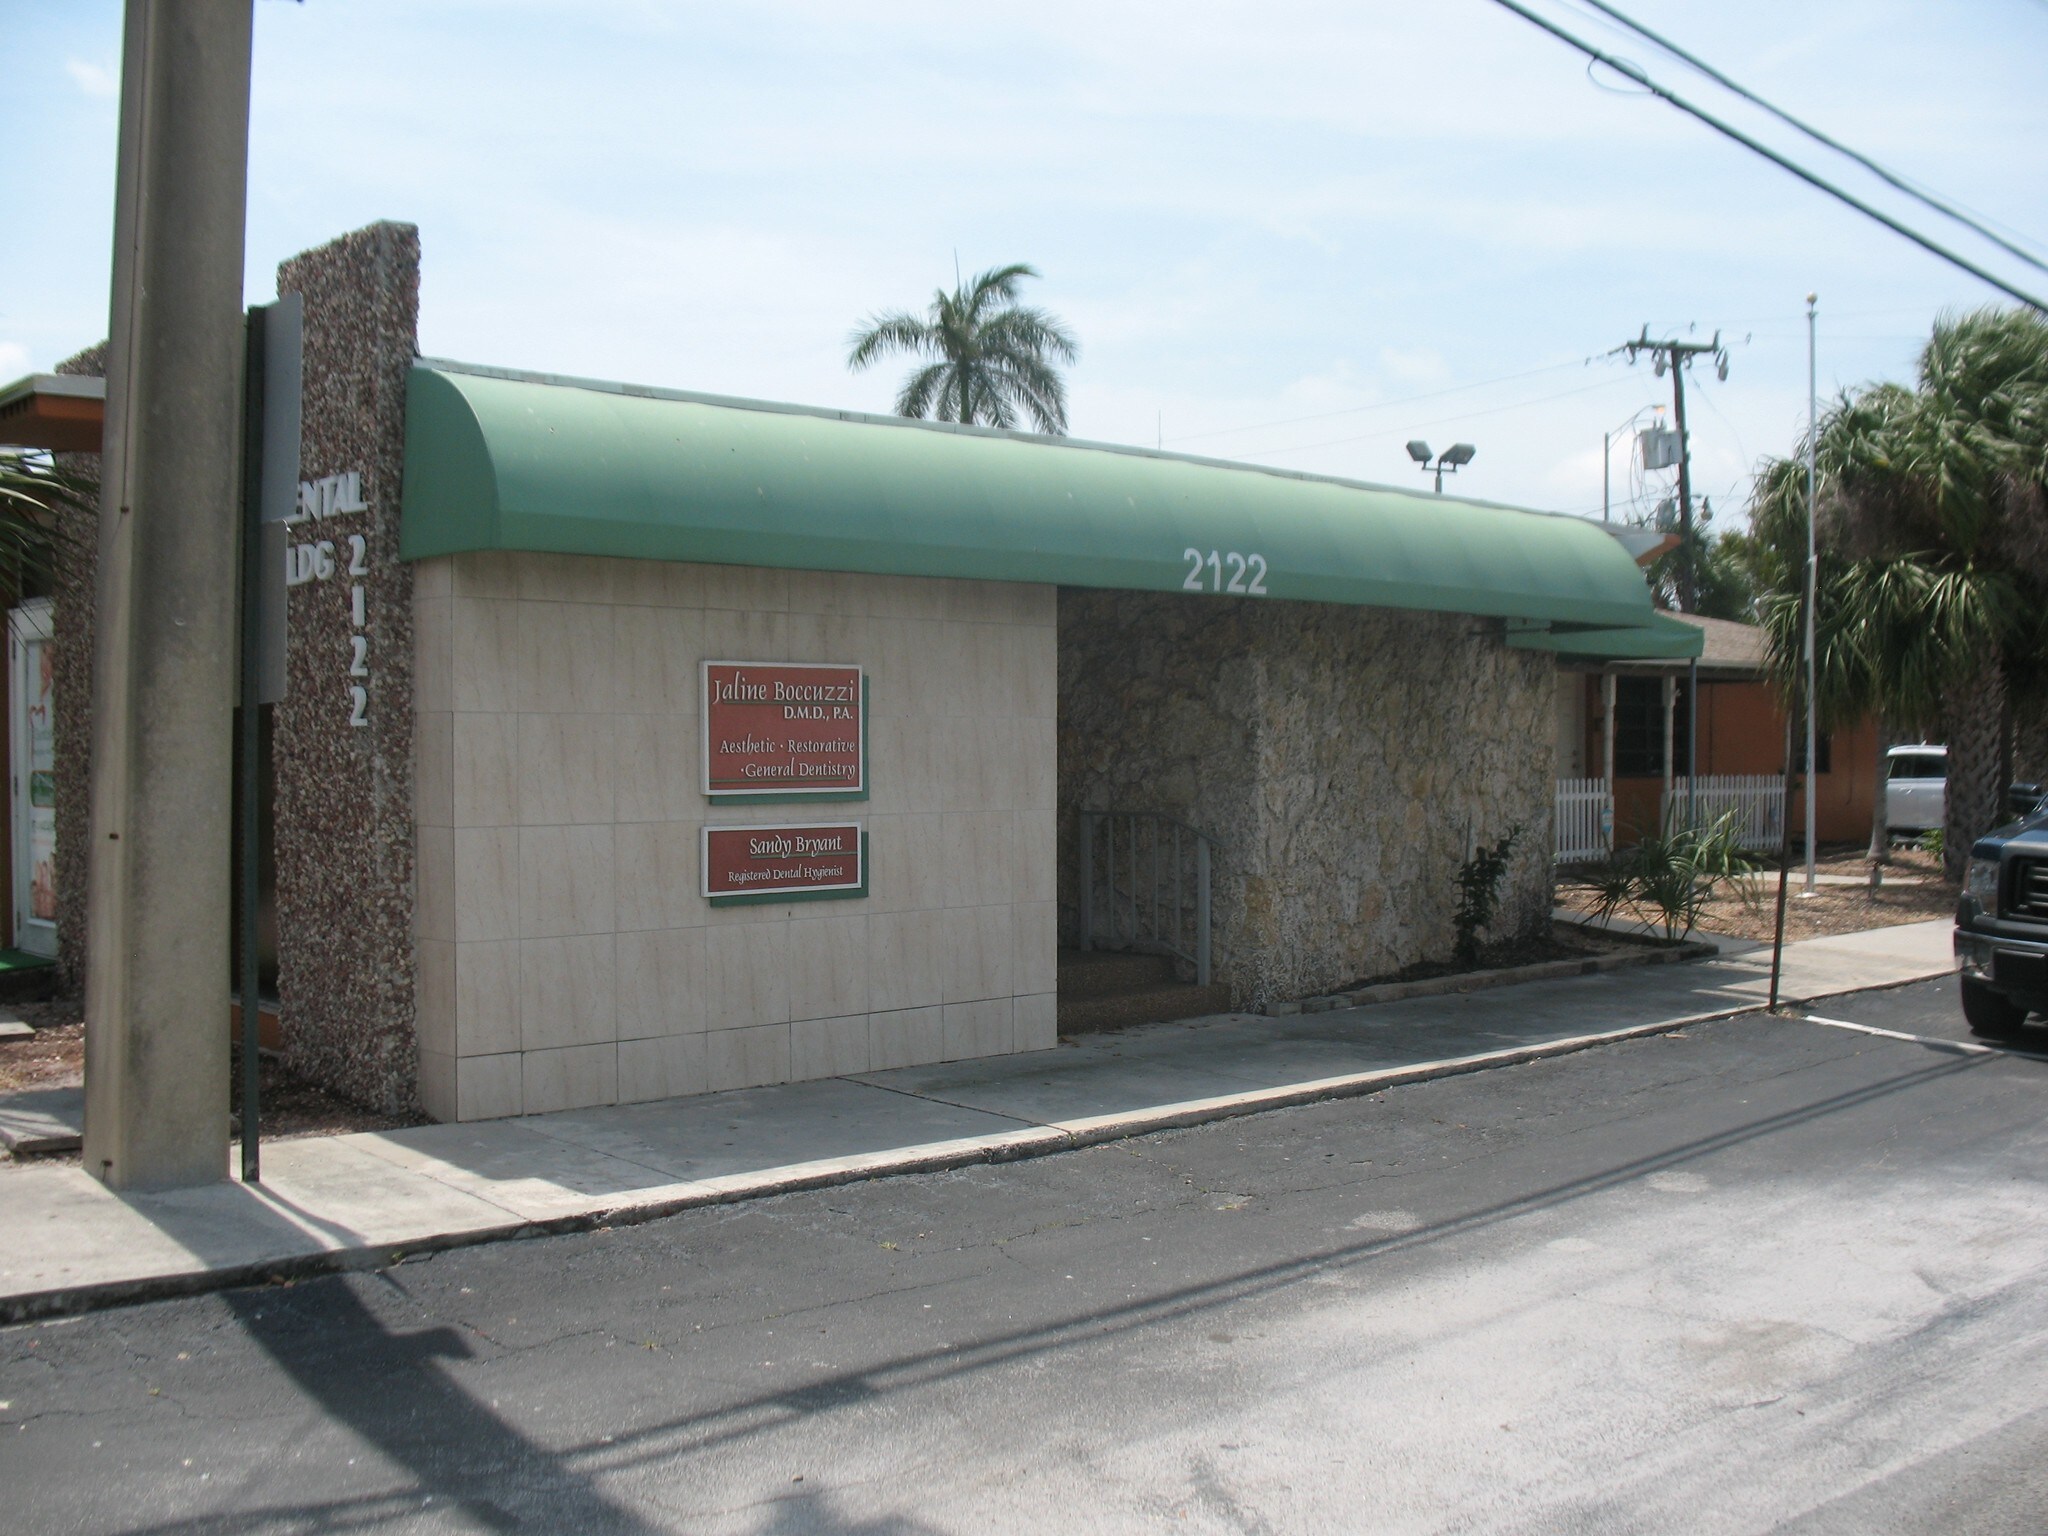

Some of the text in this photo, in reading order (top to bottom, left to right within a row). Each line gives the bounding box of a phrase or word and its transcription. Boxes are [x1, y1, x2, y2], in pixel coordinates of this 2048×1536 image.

[286, 540, 335, 586] LDG
[1183, 547, 1267, 595] 2122
[712, 671, 854, 704] Jaline Boccuzzi
[784, 706, 854, 722] D.M.D., P.A.
[720, 733, 856, 755] Aesthetic Restorative
[798, 761, 856, 780] Dentistry
[750, 834, 843, 859] Sandy Bryant
[728, 864, 843, 884] Registered Dental Hygienist
